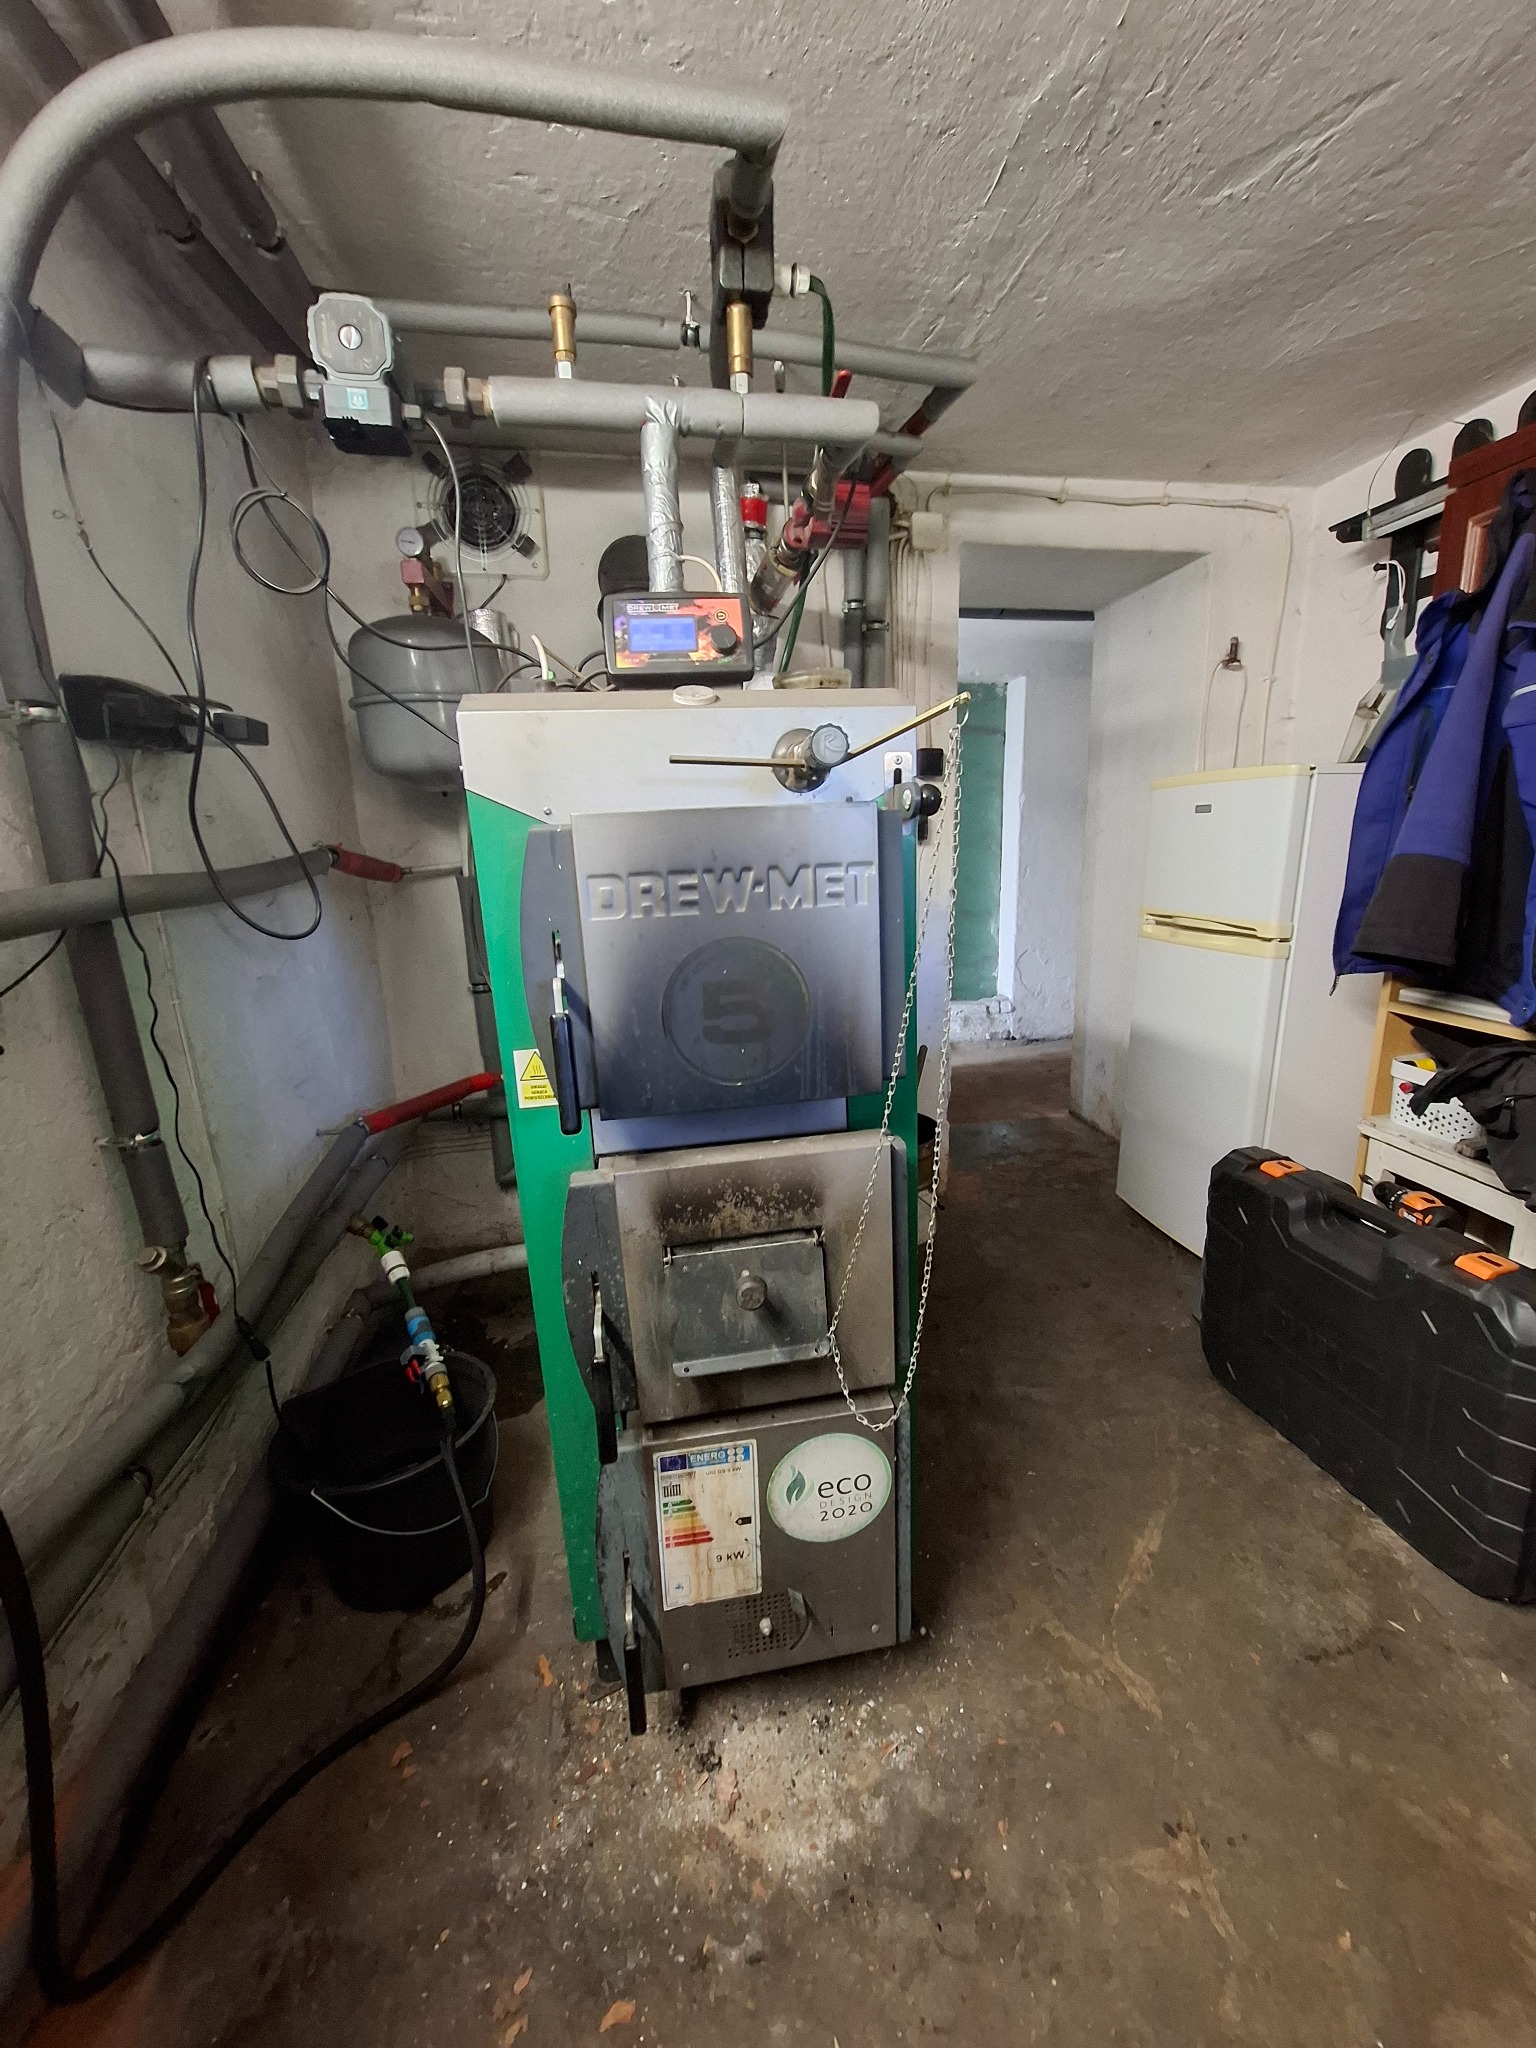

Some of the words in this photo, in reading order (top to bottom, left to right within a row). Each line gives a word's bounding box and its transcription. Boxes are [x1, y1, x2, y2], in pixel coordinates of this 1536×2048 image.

[818, 1474, 871, 1498] eco
[820, 1491, 871, 1509] DESIGN
[820, 1502, 873, 1521] 2020
[716, 1554, 722, 1562] 9
[726, 1550, 744, 1561] kW
